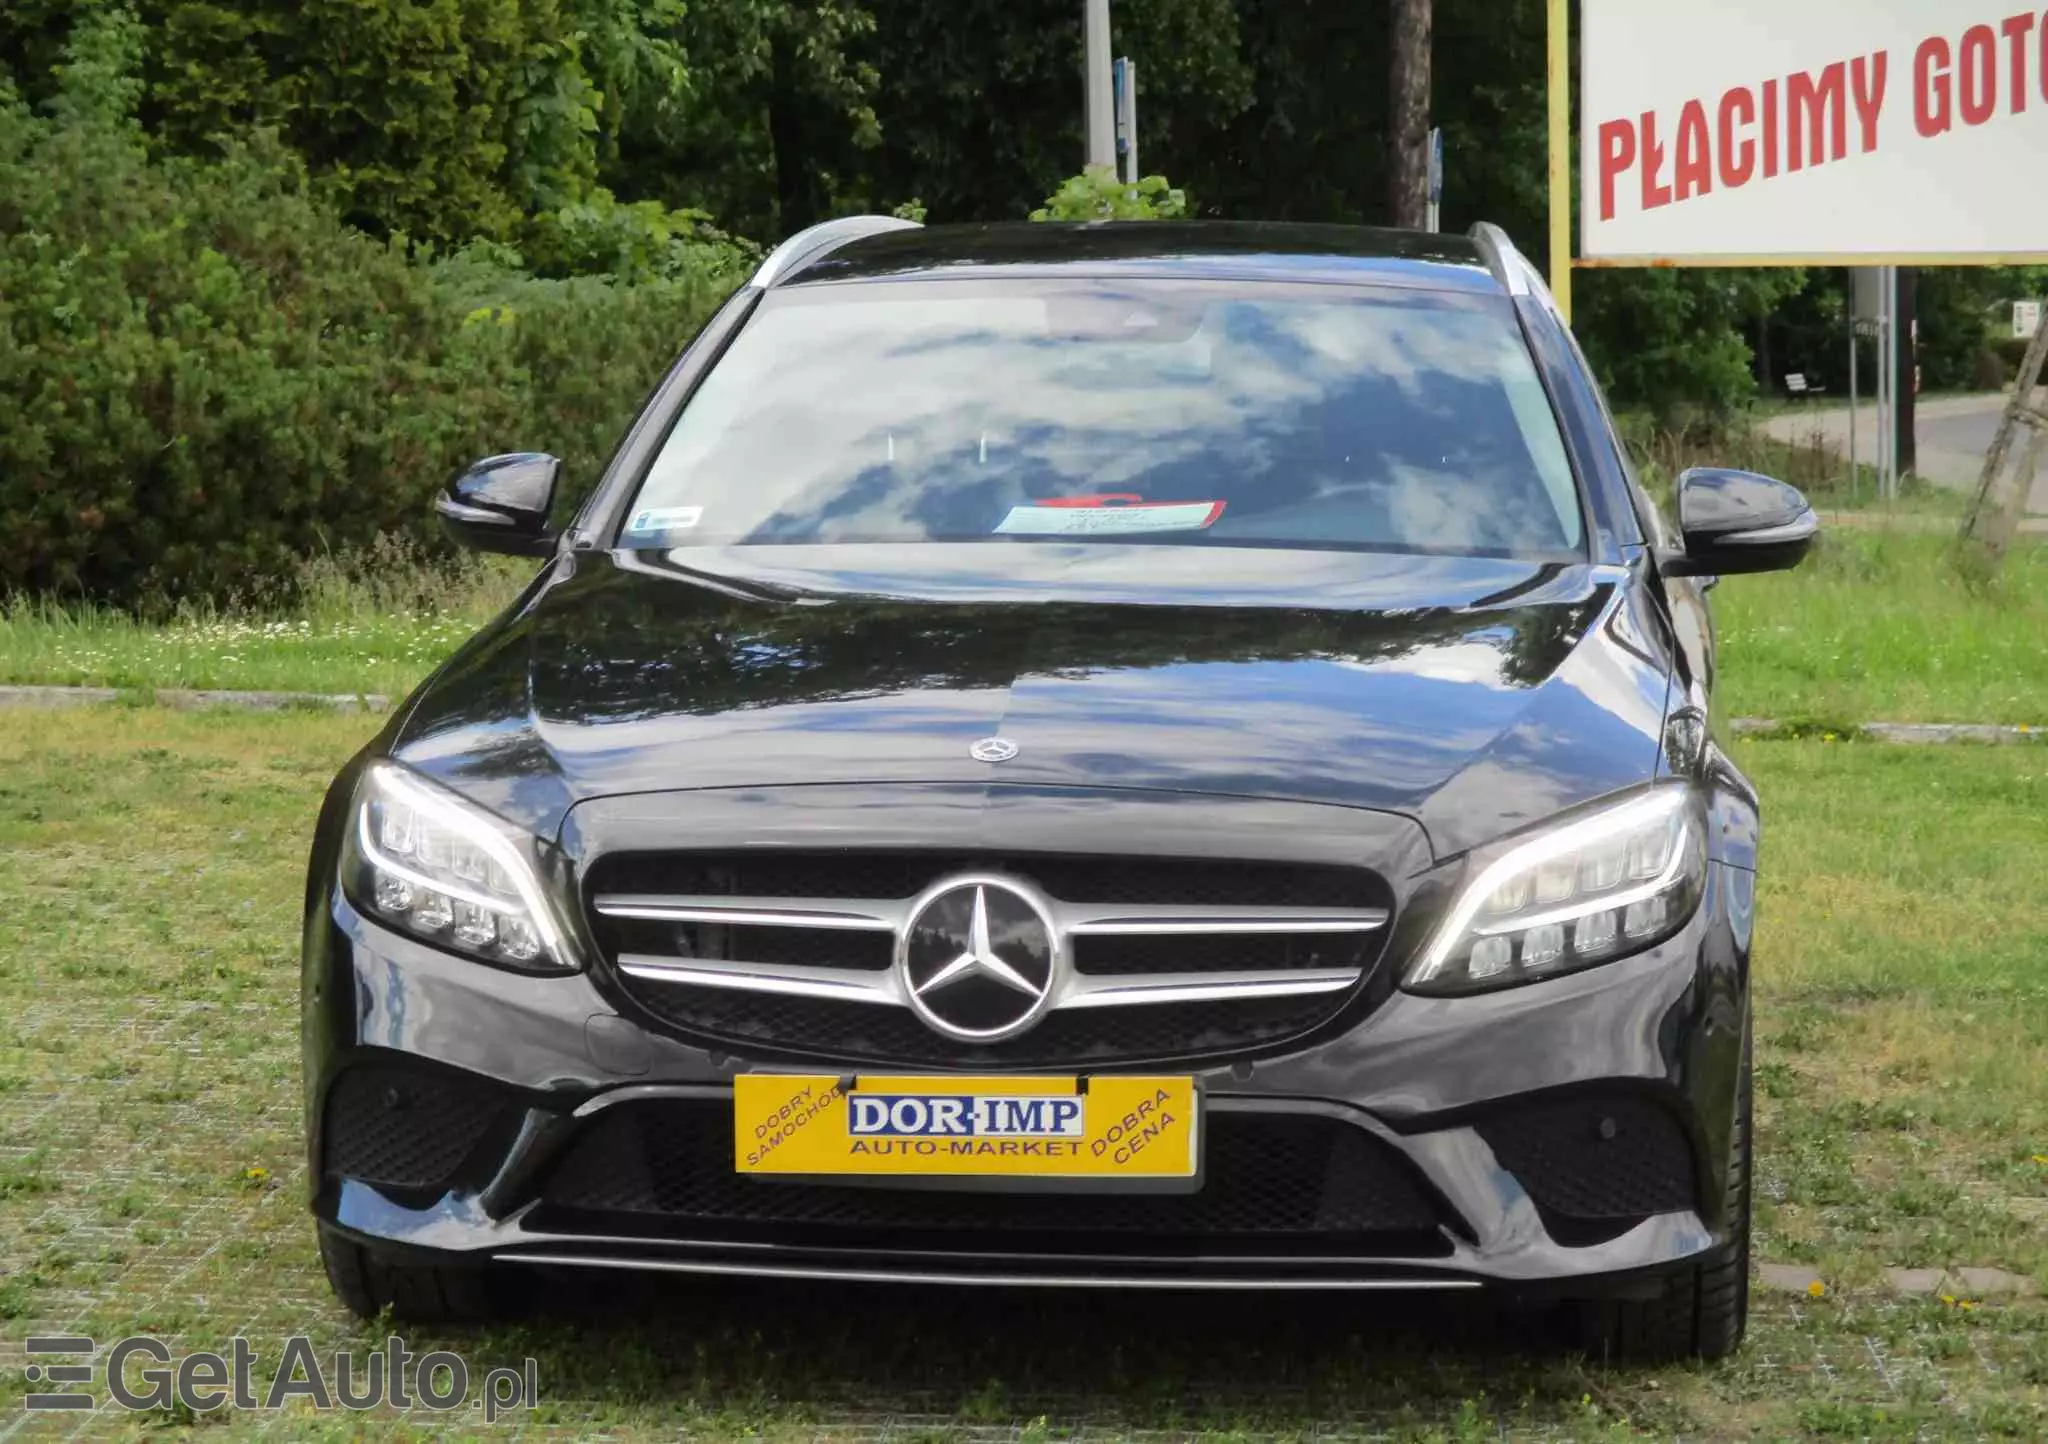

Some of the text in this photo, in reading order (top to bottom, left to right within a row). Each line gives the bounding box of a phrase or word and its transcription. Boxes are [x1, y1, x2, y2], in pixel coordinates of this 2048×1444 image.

[1598, 8, 2048, 222] PŁACIMY GOT
[755, 1084, 811, 1139] DOBRY
[852, 1097, 1079, 1134] DOR-IMP
[1090, 1087, 1171, 1157] DOBRA
[1113, 1112, 1176, 1165] CENA
[850, 1140, 1084, 1156] AUTO-MARKET
